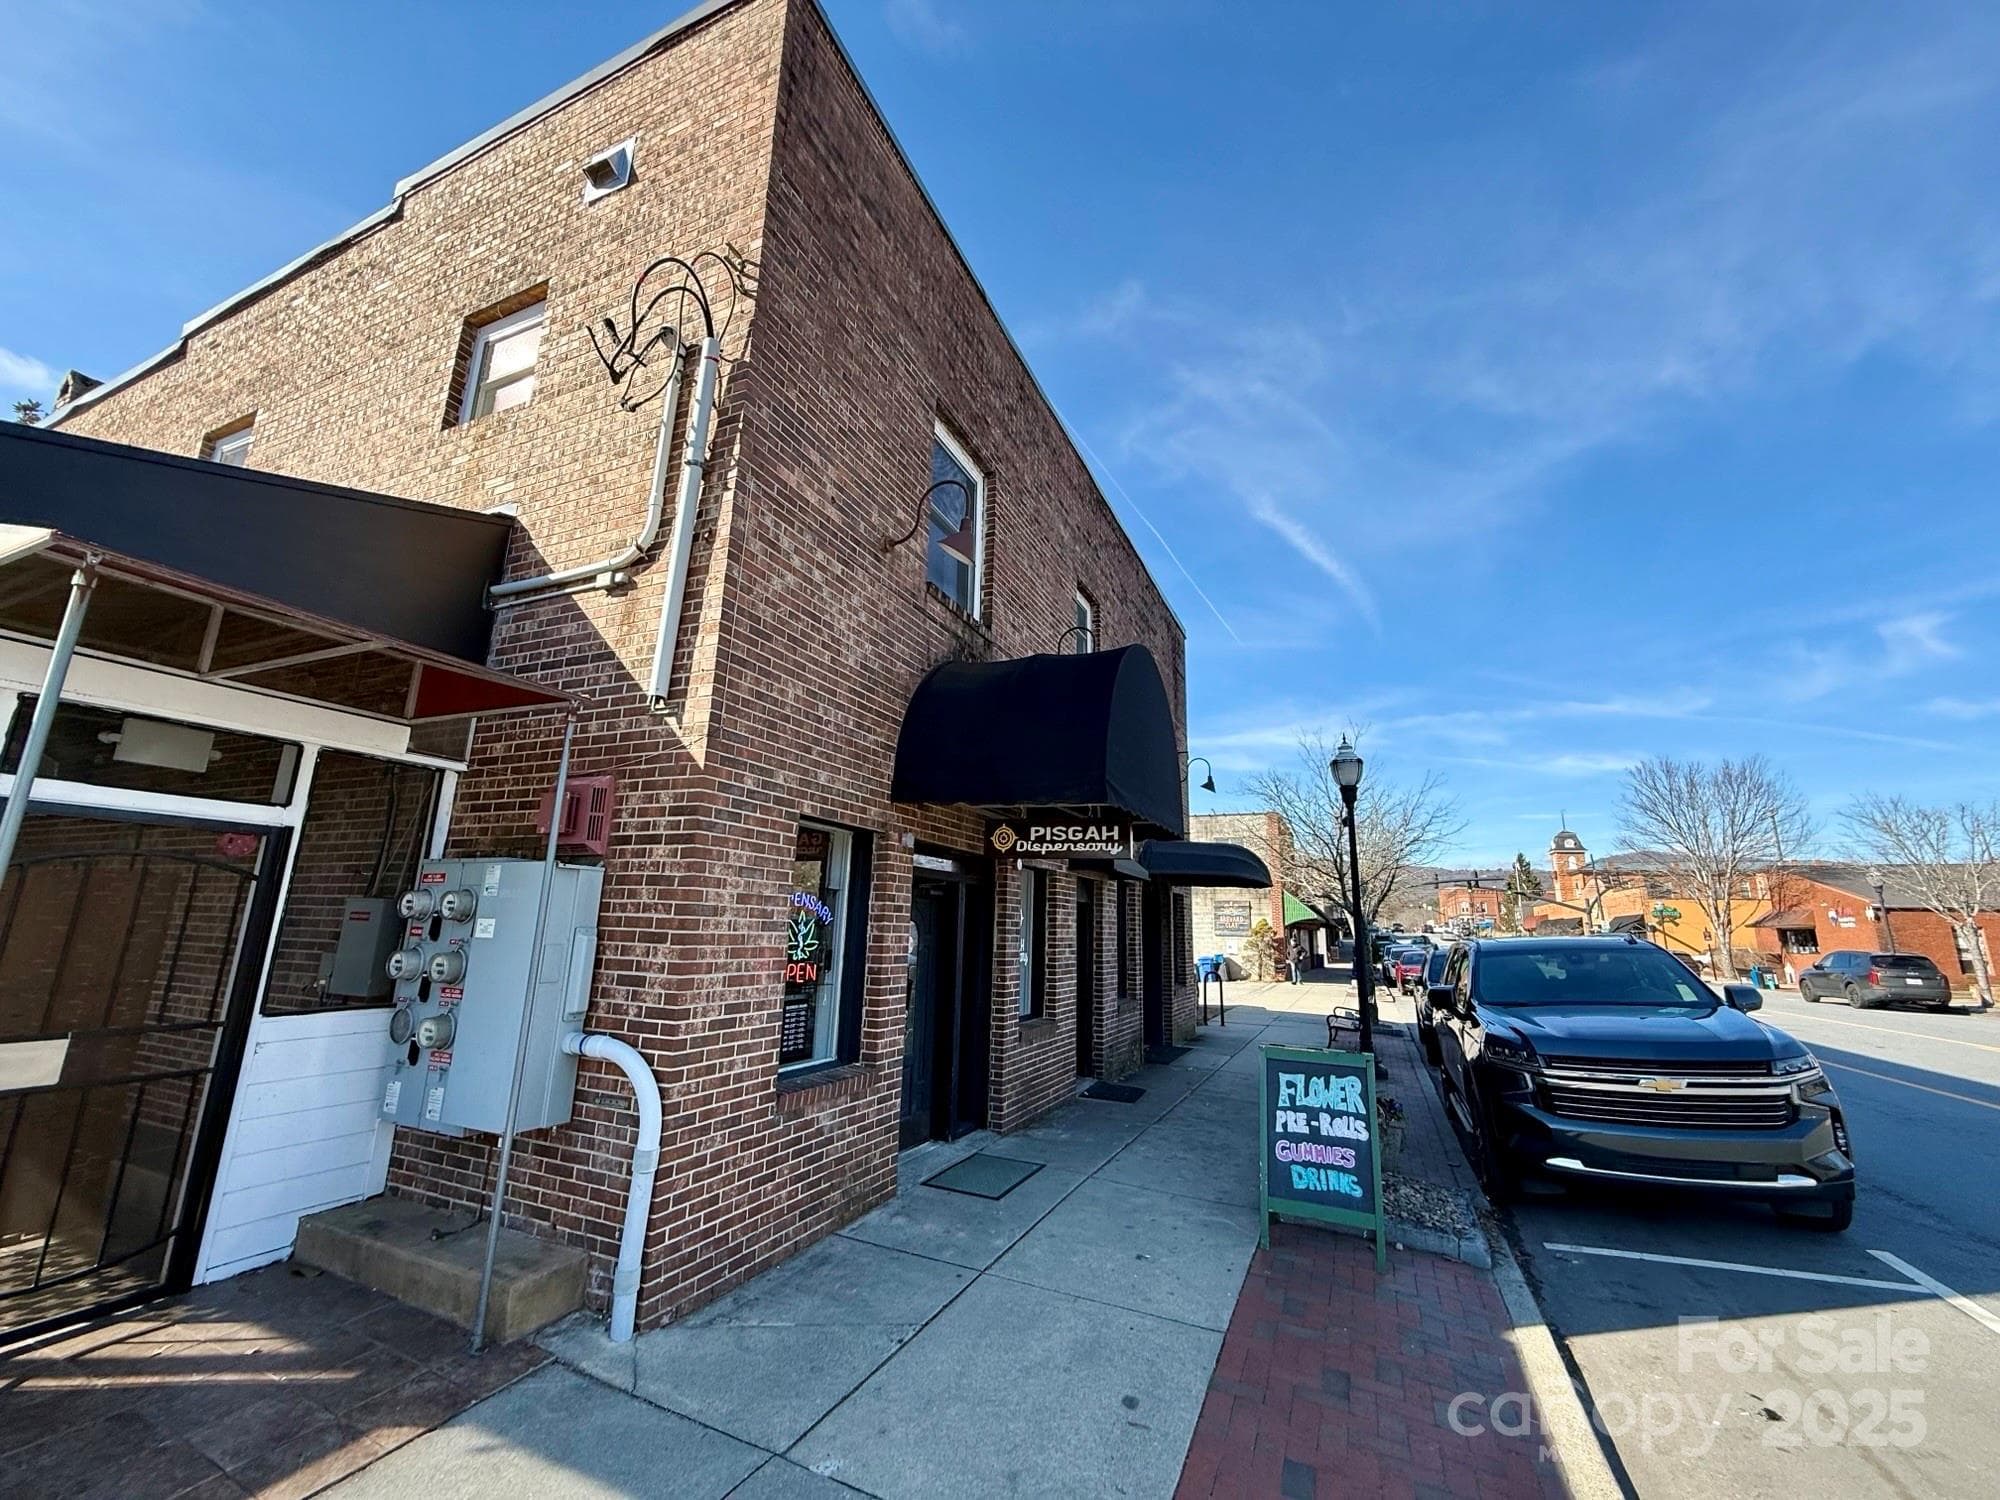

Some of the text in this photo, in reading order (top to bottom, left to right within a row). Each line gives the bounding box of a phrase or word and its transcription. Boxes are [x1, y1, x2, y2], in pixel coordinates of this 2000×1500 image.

[1016, 840, 1123, 855] Dispensary
[1030, 825, 1119, 841] PISGAH
[786, 963, 817, 983] PEN
[1278, 1072, 1366, 1114] FLOWER
[1275, 1110, 1370, 1142] PRE-ROLLS
[1275, 1139, 1356, 1169] GUMMIES
[1290, 1164, 1363, 1198] DRINKS
